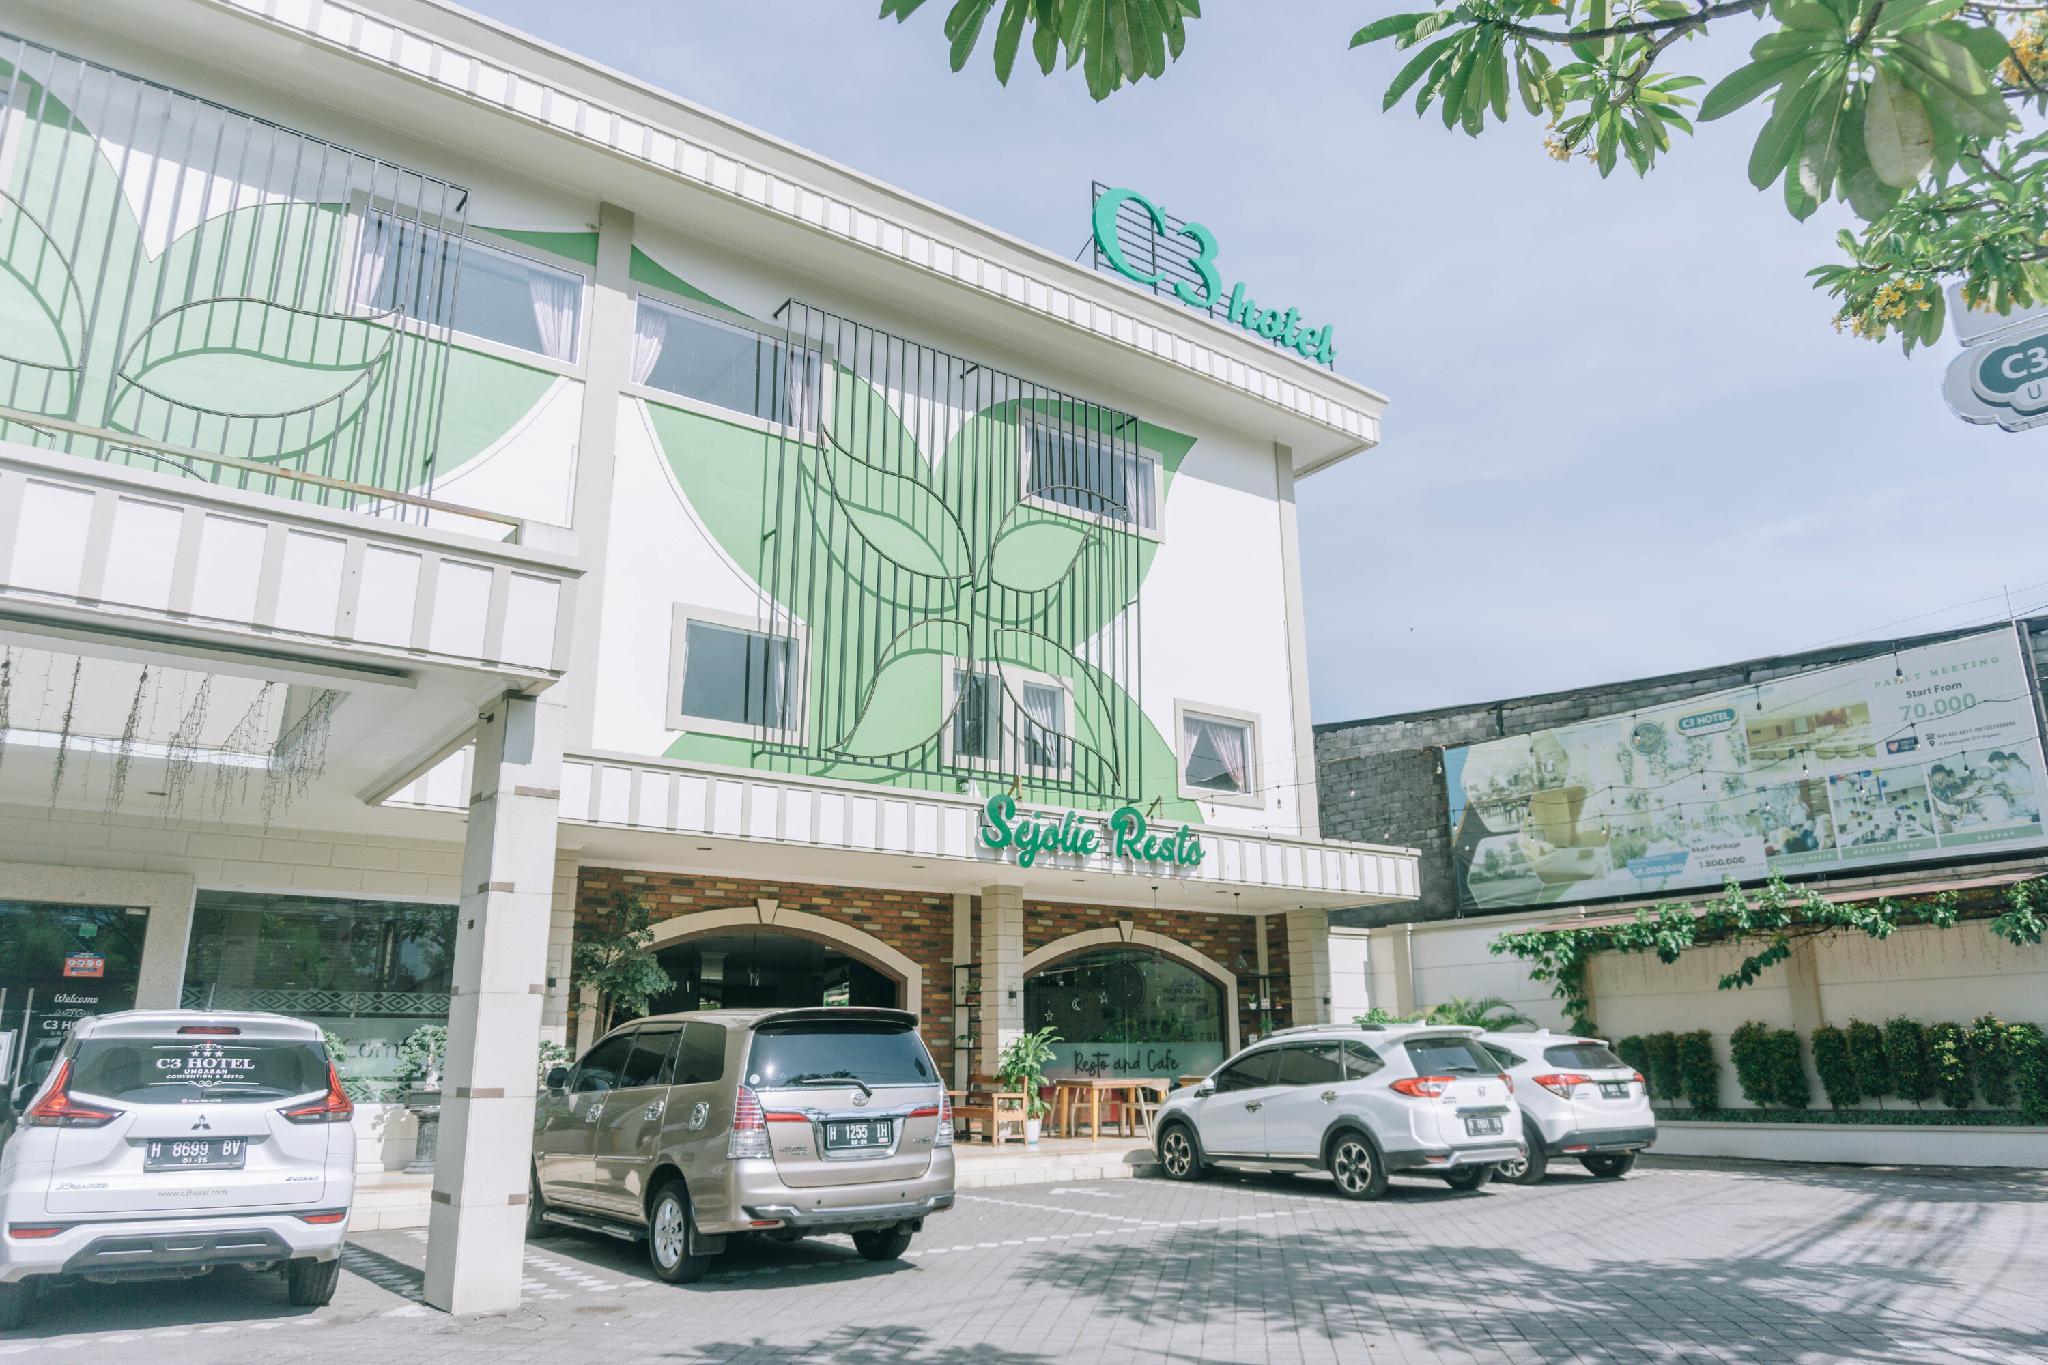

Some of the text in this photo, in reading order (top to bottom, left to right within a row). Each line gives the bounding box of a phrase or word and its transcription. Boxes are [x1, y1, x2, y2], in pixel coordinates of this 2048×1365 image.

[1092, 188, 1338, 364] C3 hotel
[2002, 346, 2048, 379] C3
[1930, 656, 2000, 677] MEETING
[1906, 681, 1963, 699] Start From
[1899, 692, 1977, 721] 70.000
[1697, 711, 1731, 726] HOTEL
[982, 793, 1206, 869] Sejolie Resto
[54, 993, 99, 1004] Welcome
[43, 1020, 59, 1030] C3
[156, 1058, 256, 1070] C3 HOTEL
[1074, 1048, 1180, 1078] Resto and Cafe
[830, 1126, 837, 1141] H
[846, 1124, 868, 1139] 1255
[151, 1139, 241, 1158] H 8699 BV
